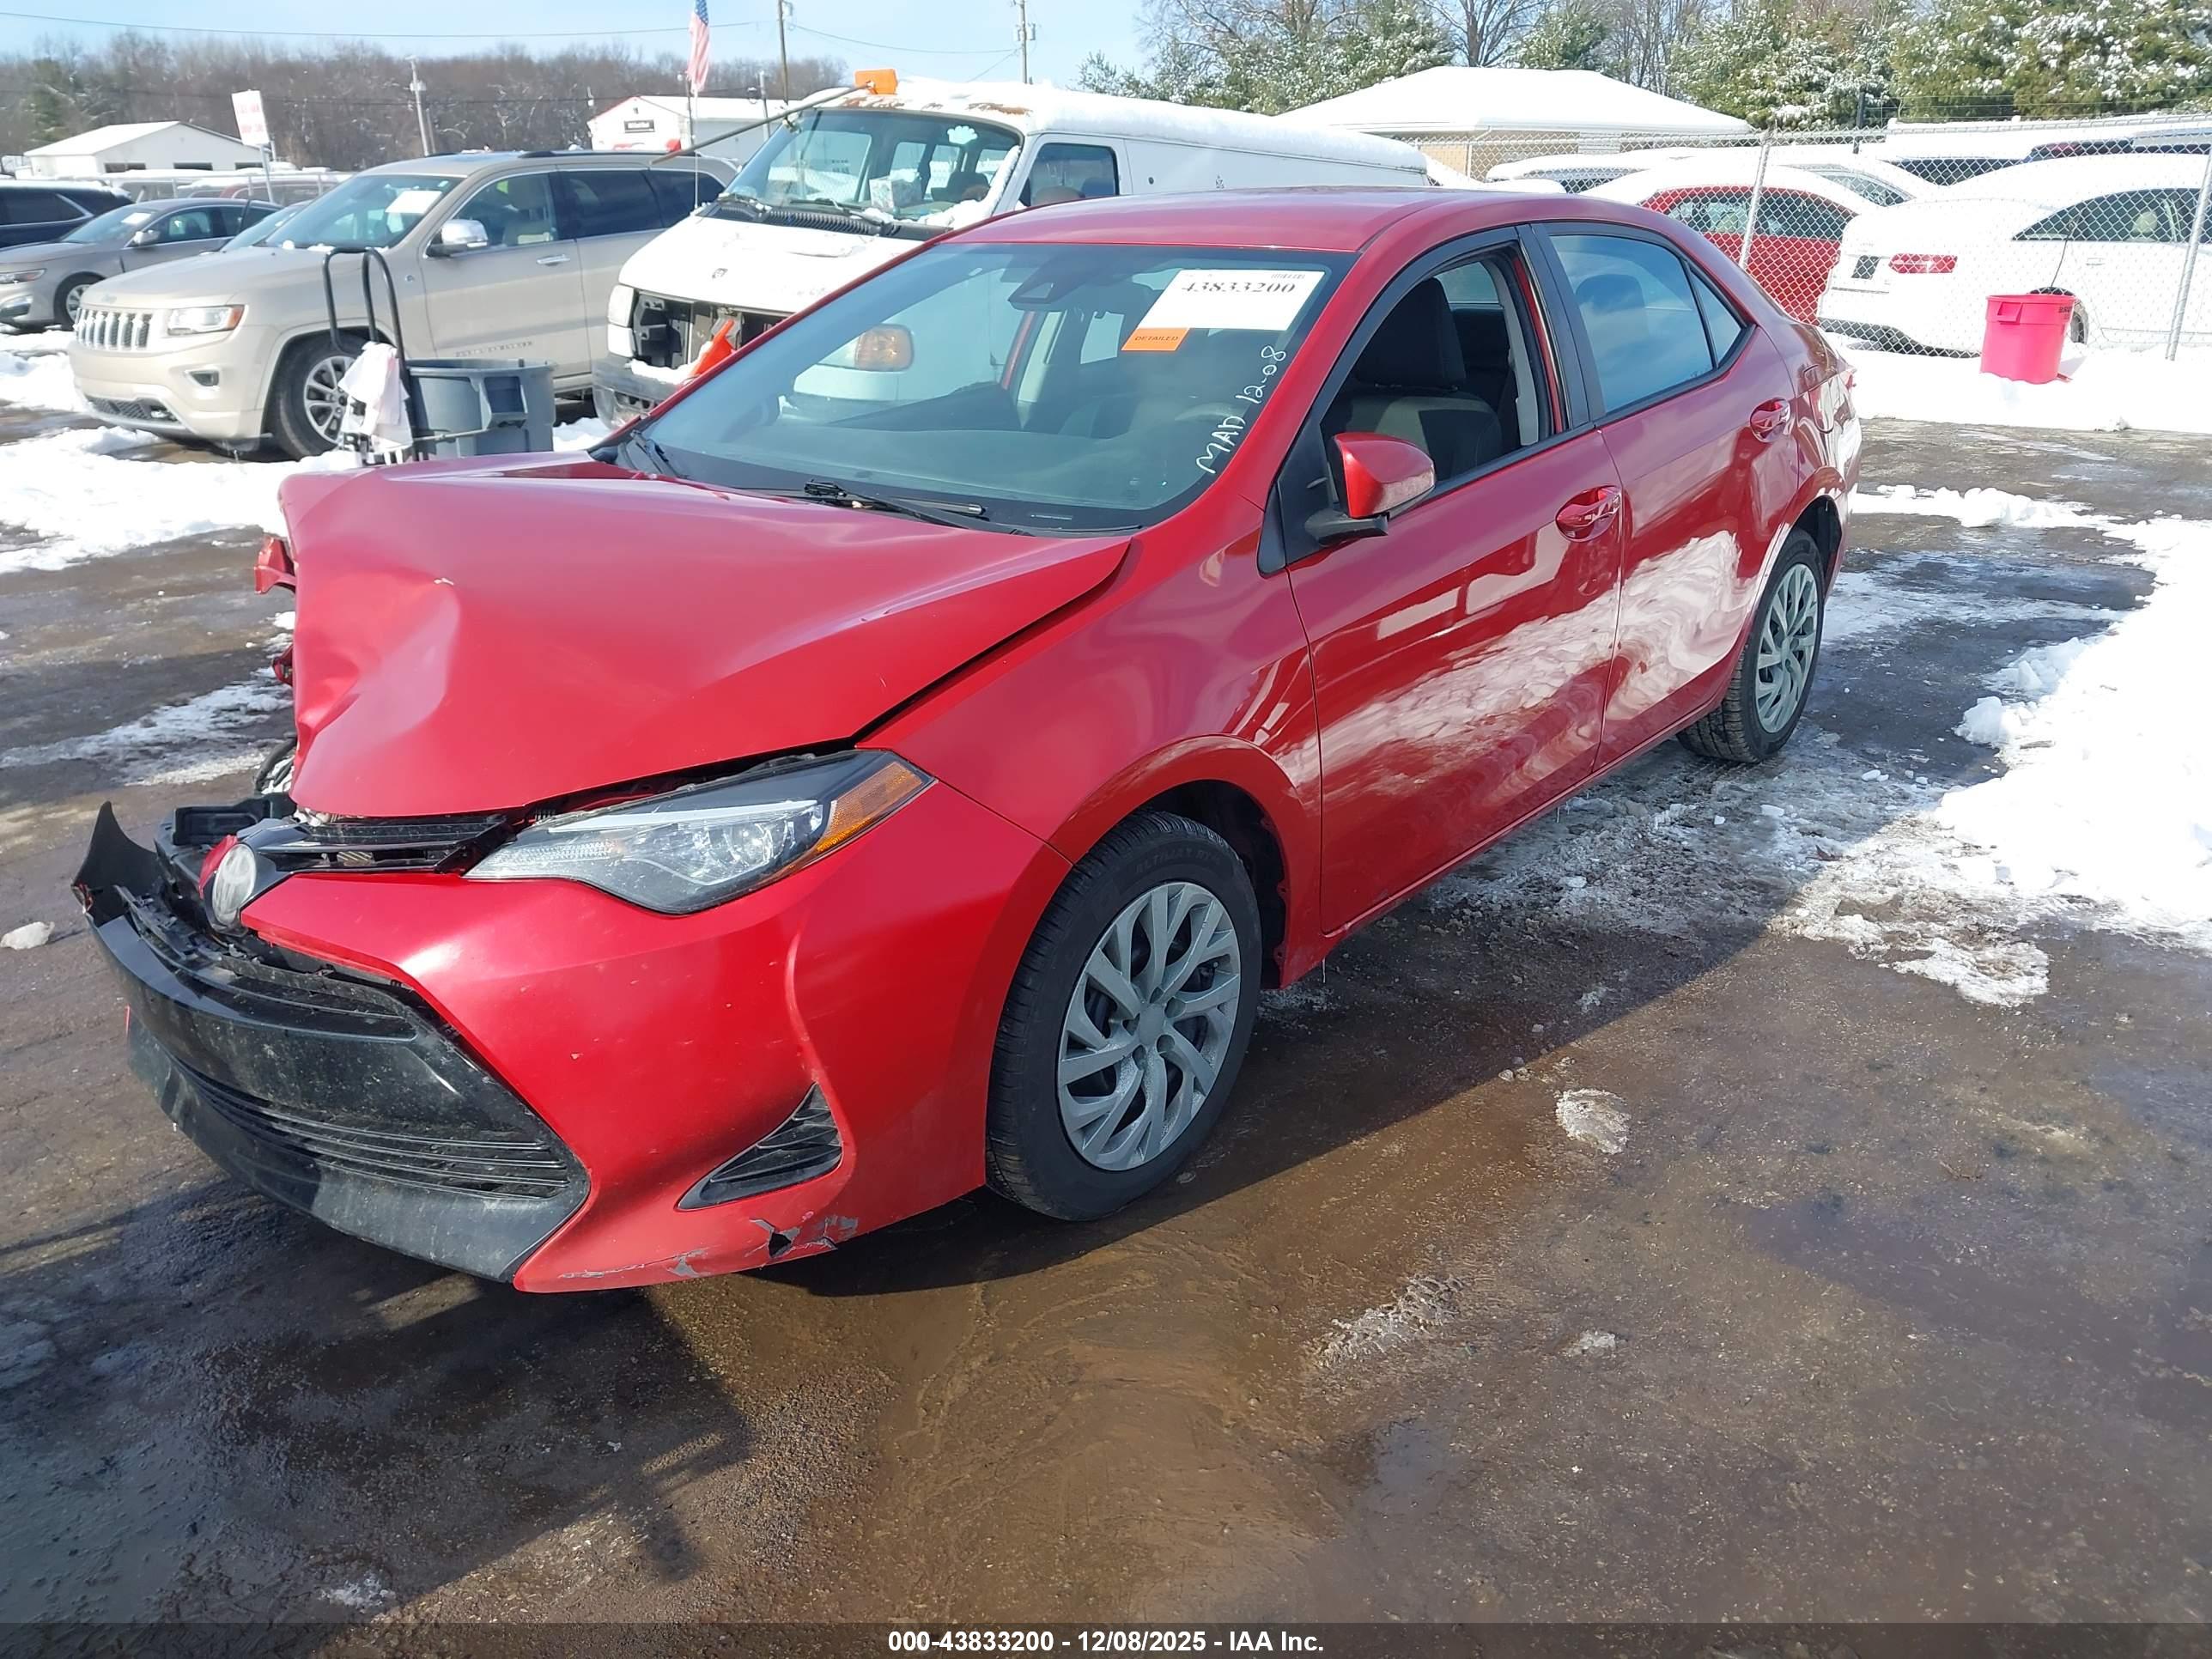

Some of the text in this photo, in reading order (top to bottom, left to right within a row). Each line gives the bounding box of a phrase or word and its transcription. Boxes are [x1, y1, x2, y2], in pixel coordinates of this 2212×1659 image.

[1182, 281, 1296, 293] 43833200
[1195, 345, 1286, 474] MAD 12-08
